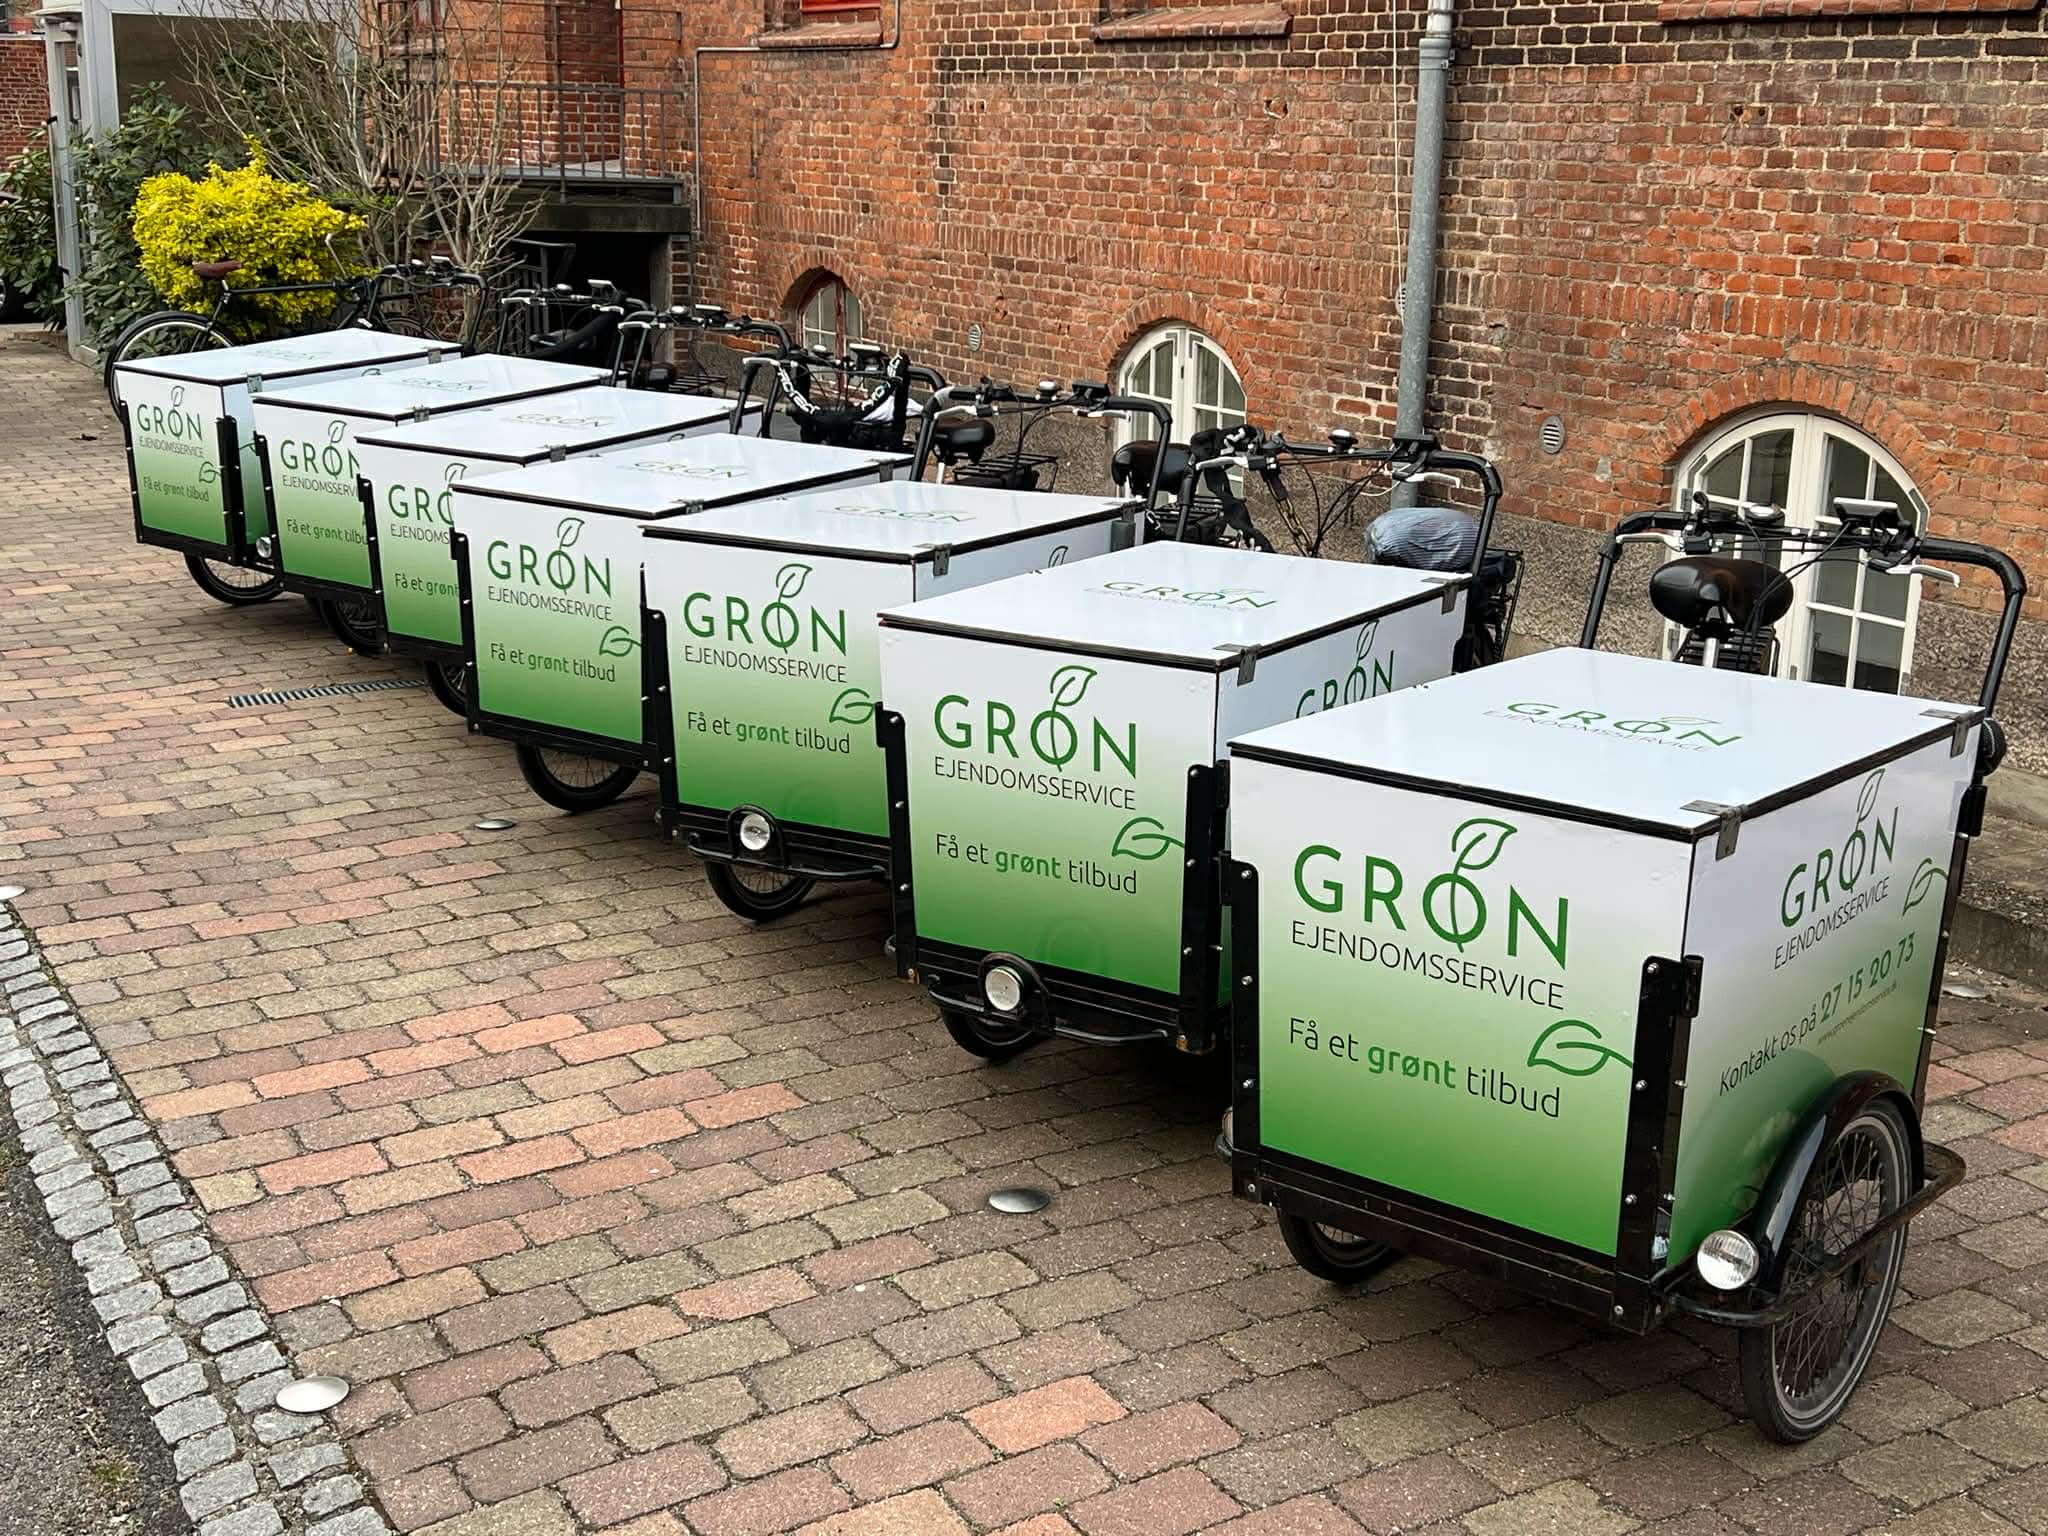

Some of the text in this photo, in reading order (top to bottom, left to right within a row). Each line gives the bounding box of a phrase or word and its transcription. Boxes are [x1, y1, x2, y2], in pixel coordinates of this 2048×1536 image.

[287, 518, 368, 545] Få et grønt tilbu
[388, 484, 454, 526] GRØ
[390, 523, 450, 545] EJENDOMS
[394, 572, 408, 589] Få
[411, 577, 424, 591] et
[487, 540, 612, 598] GRØN
[488, 585, 613, 622] EJENDOMSSERVICE
[684, 592, 847, 656] GRØN
[490, 642, 616, 682] Få et grønt tilbud
[684, 644, 848, 683] EJENDOMSSERVICE
[687, 711, 851, 754] Få et grønt tilbud
[934, 695, 1136, 779] GRØN
[934, 757, 1137, 811] EJENDOMSSERVICE
[936, 833, 1137, 895] Få et grønt tilbud
[1294, 844, 1569, 971] GRØN
[1774, 876, 1890, 971] EJENDOMSSERVICE
[1291, 920, 1565, 1010] EJENDOMSSERVICE
[1719, 1038, 1778, 1097] Kontakt
[1781, 1026, 1797, 1051] os
[1799, 1003, 1817, 1046] på
[1820, 982, 1842, 1024] 27
[1848, 967, 1864, 1005] 15
[1869, 949, 1892, 990] 20
[1897, 931, 1916, 970] 73
[1290, 1017, 1561, 1118] Få et grønt tilbud
